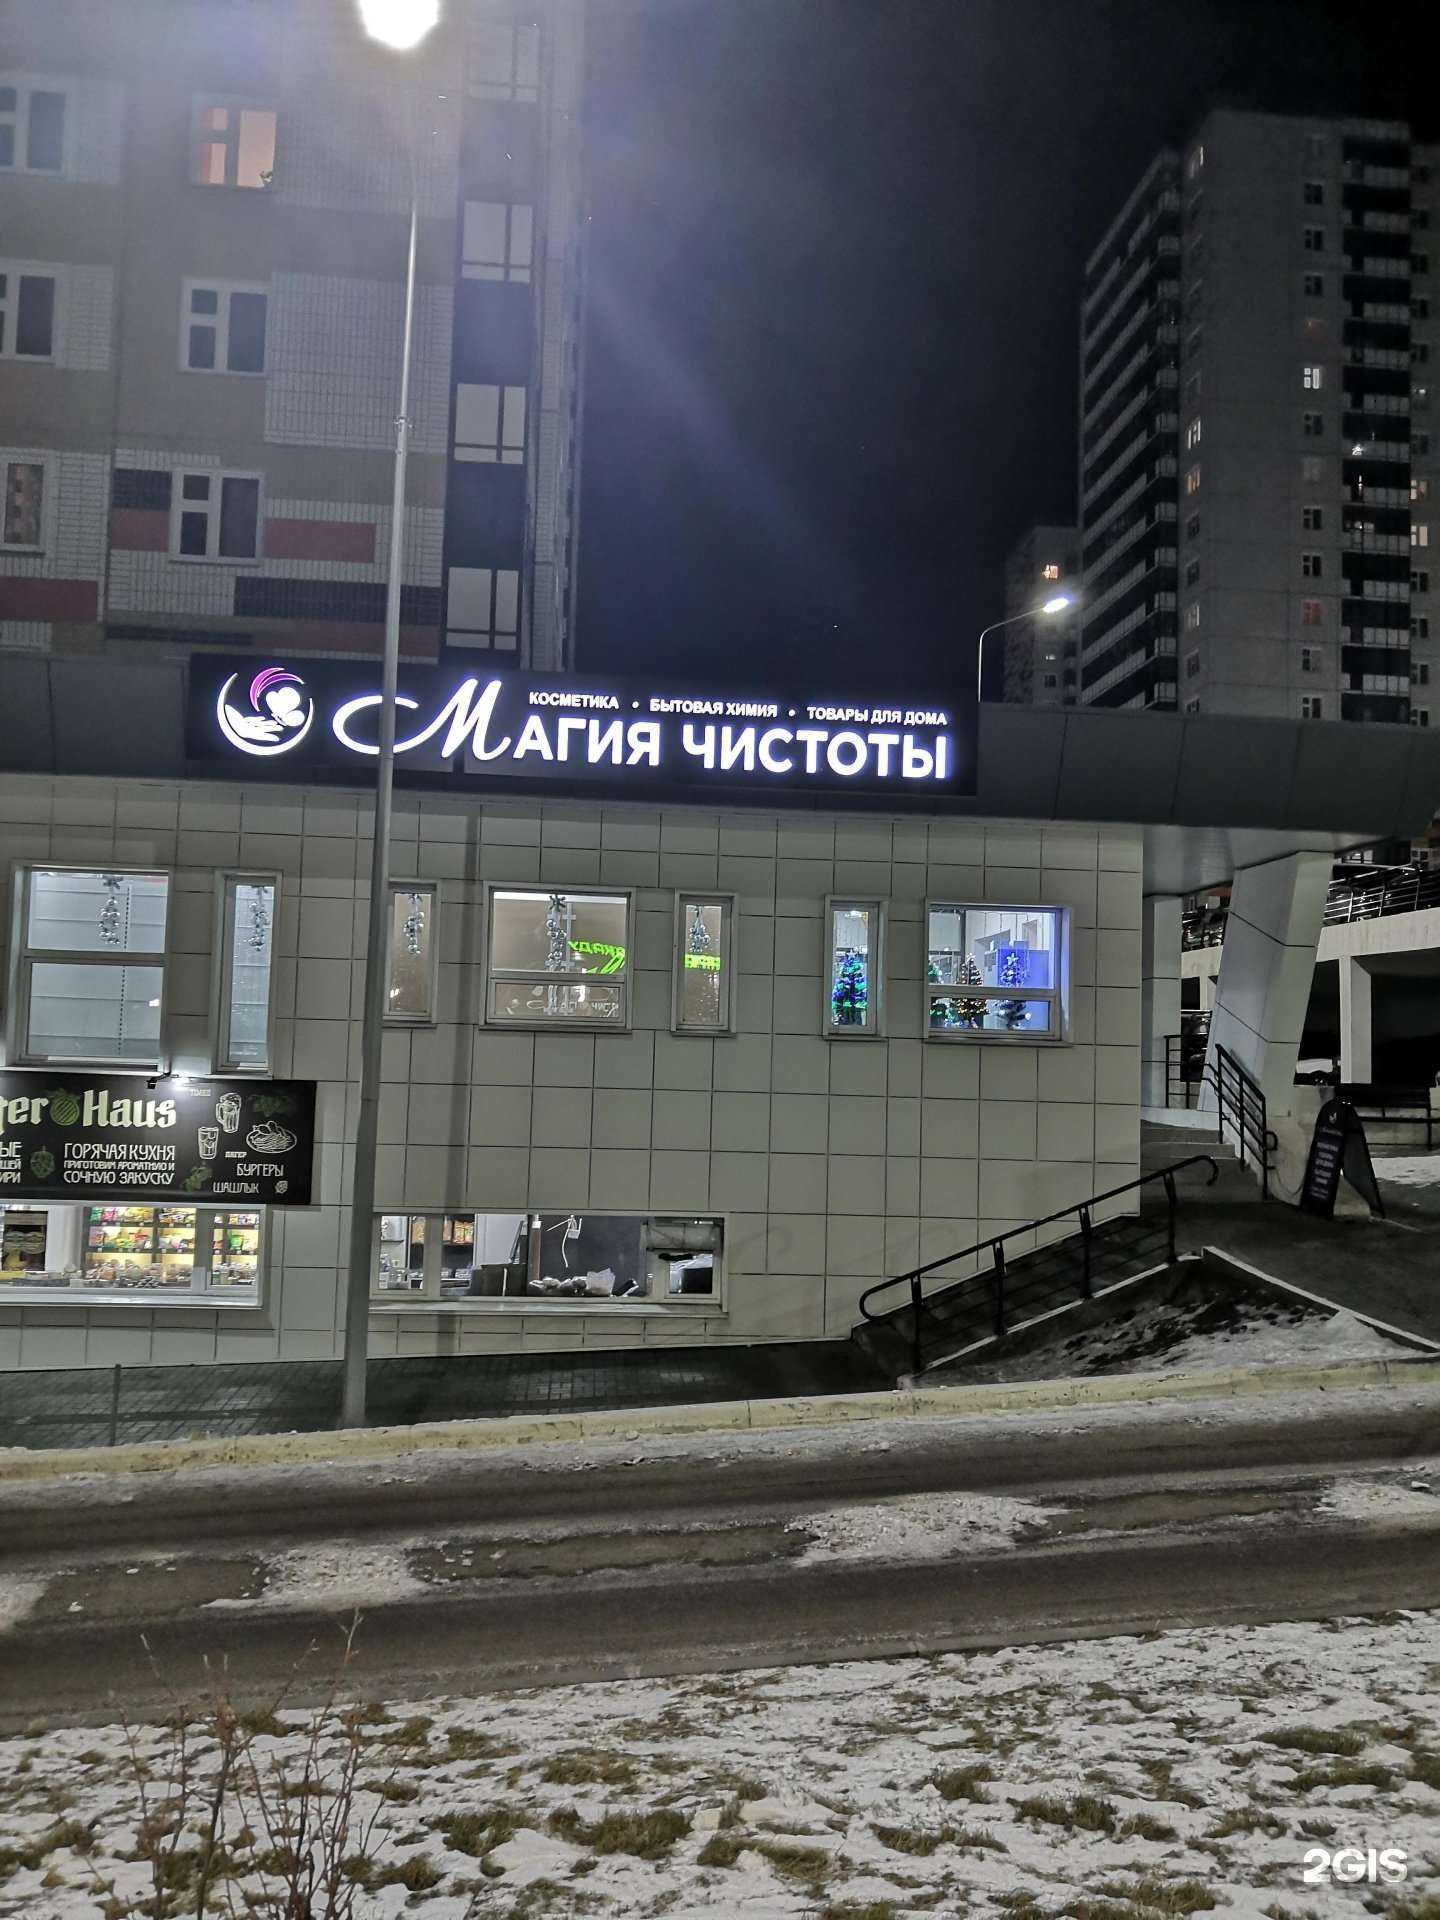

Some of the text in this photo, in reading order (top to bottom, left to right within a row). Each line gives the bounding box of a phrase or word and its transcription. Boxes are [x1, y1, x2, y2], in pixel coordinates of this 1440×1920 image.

[529, 692, 947, 726] КОСМЕТИКА БЫТОВАЯ ХИМИЯ ТОВАРЫ ДЛЯ ДОМА
[332, 678, 947, 779] МАГИЯ ЧИСТОТЫ
[82, 1089, 177, 1128] Haus
[64, 1143, 176, 1161] ГОРЯЧАЯ КУХНЯ
[64, 1160, 175, 1171] ПРИГОТОВИМ АРОМАТНУЮ И
[236, 1163, 284, 1177] БУРГЕРЫ
[64, 1170, 175, 1185] СОЧНУЮ ЗАКУСКУ
[212, 1181, 260, 1194] ШАШЛЫК
